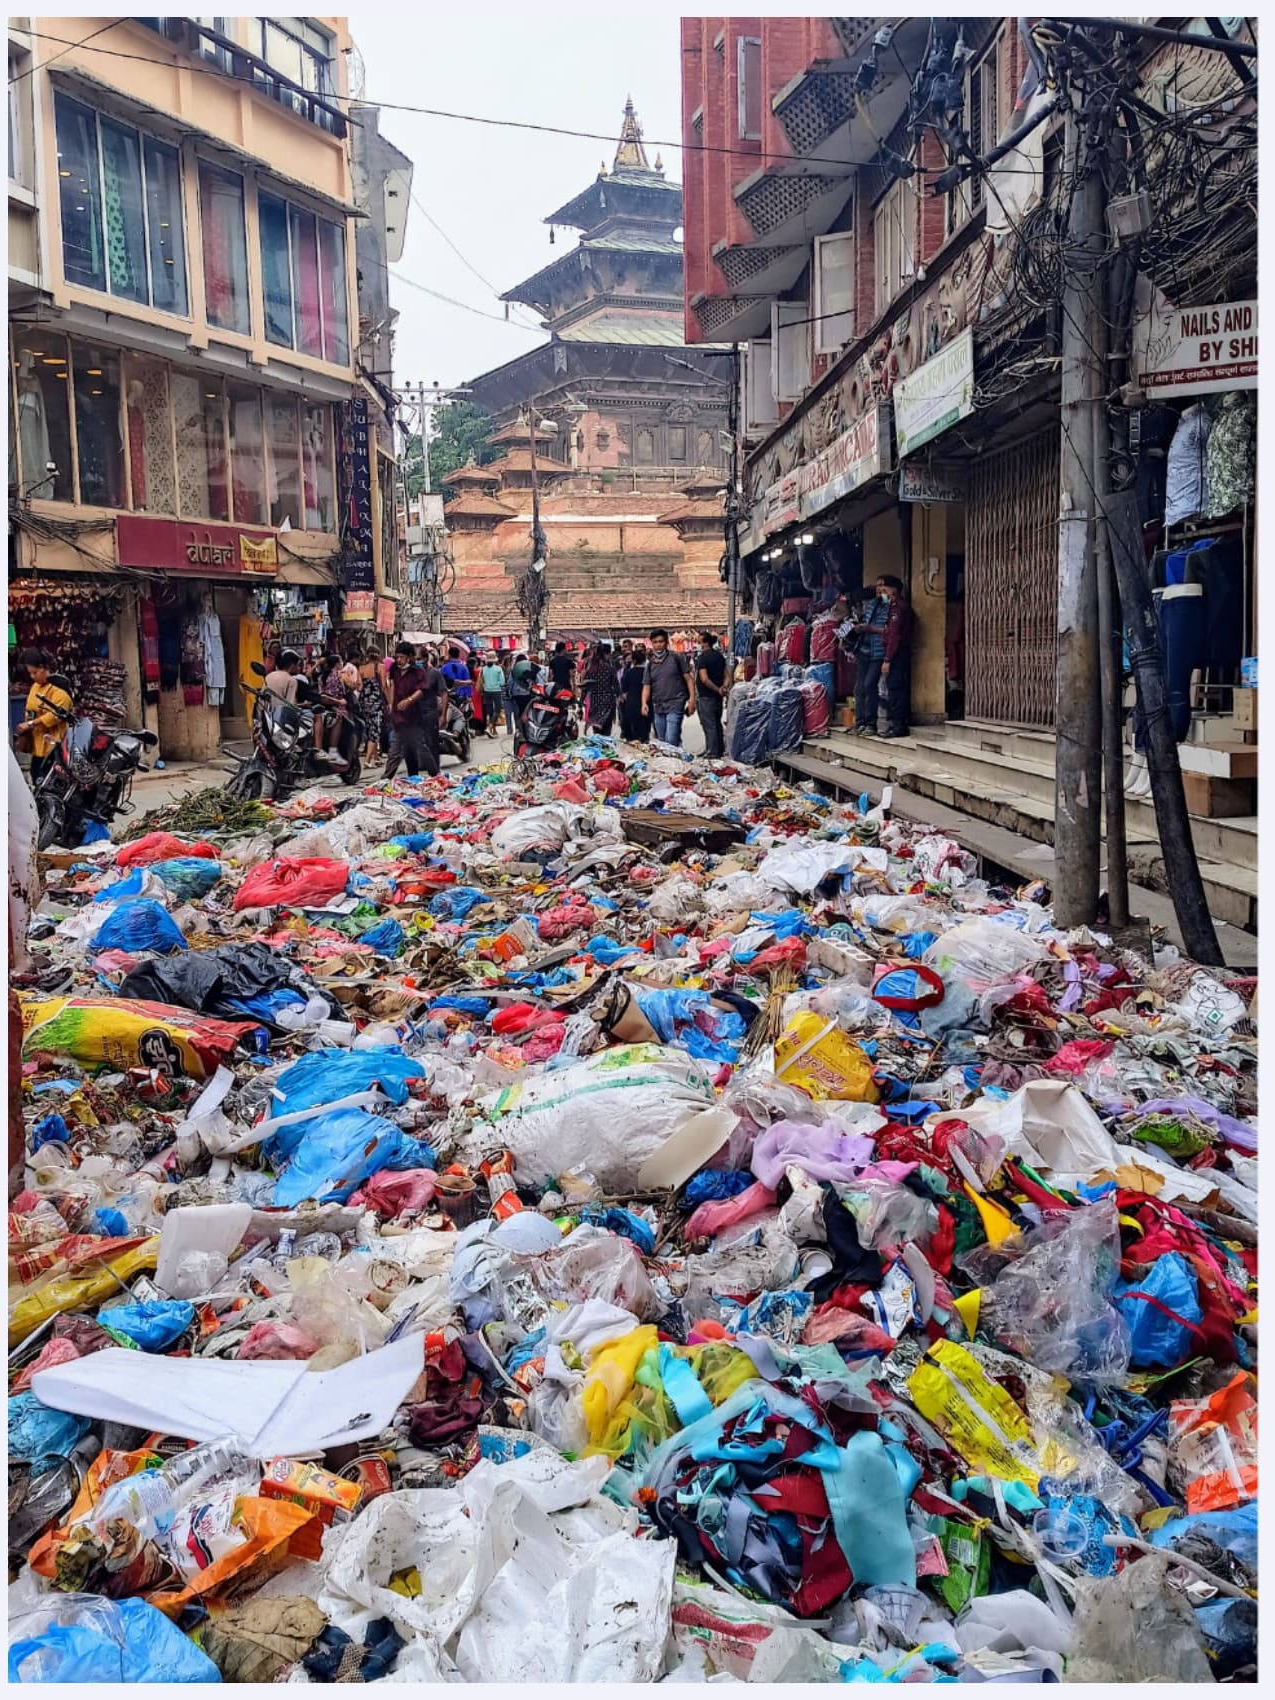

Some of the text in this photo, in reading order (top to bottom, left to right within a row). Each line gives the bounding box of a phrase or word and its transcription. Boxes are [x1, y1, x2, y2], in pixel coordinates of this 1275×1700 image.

[1181, 306, 1253, 338] NAILS AND
[1199, 340, 1223, 362] BY
[903, 483, 922, 497] Gold
[926, 485, 951, 501] Silver
[186, 531, 236, 567] dulari
